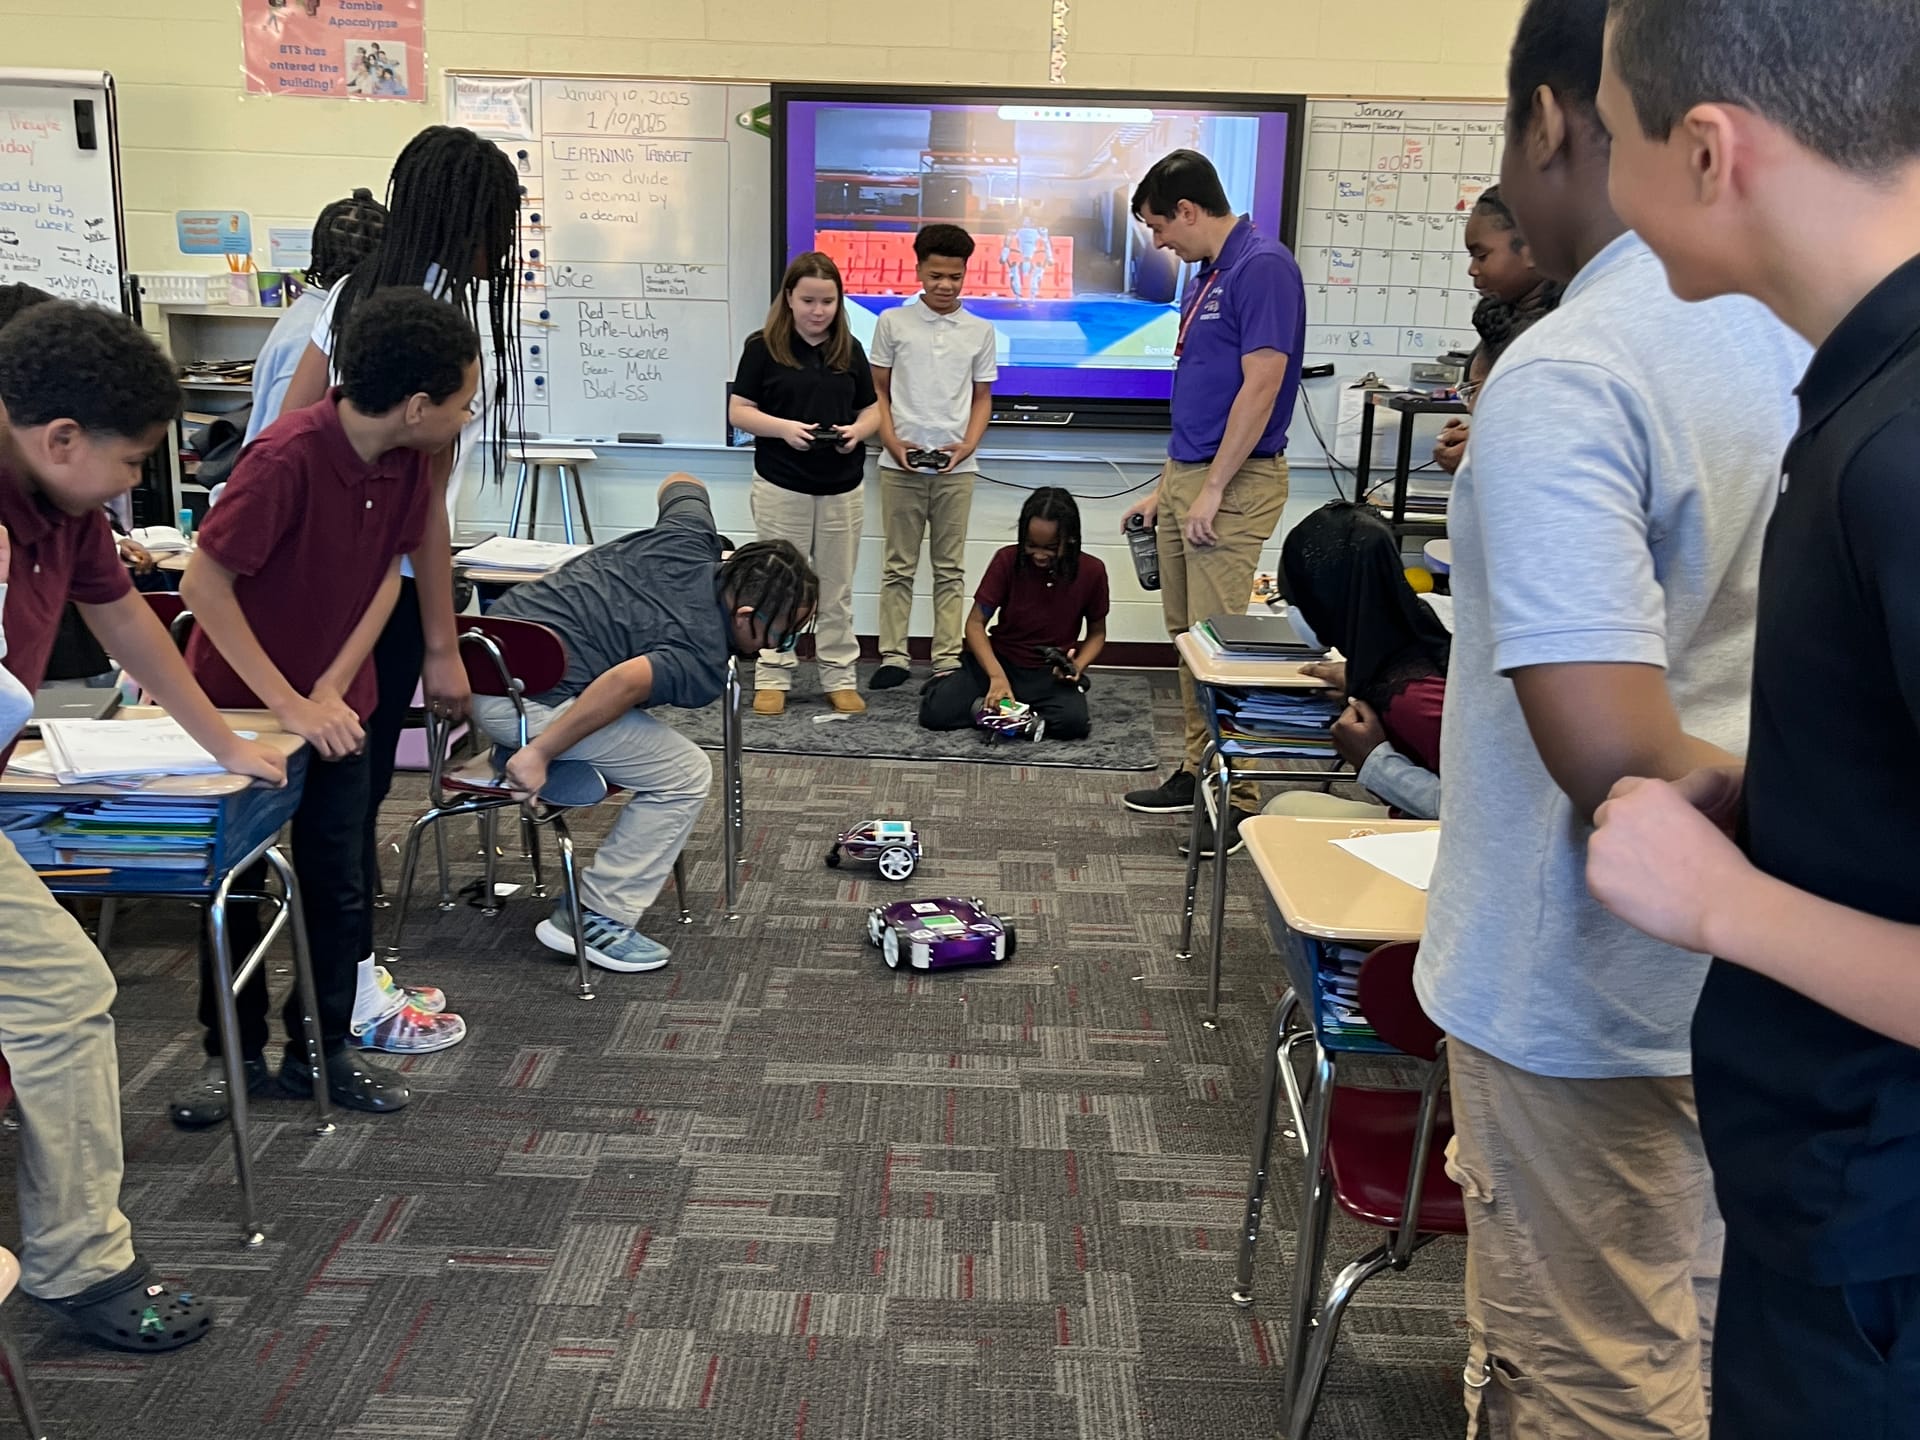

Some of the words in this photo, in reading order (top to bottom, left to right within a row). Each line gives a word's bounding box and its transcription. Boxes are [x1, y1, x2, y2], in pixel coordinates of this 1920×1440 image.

[339, 0, 383, 11] Zombie
[329, 16, 398, 30] Apocalypse
[280, 45, 302, 54] BTS
[305, 45, 327, 56] has
[269, 61, 316, 72] entered
[320, 63, 339, 73] the
[280, 77, 334, 91] building!
[557, 86, 619, 106] January
[623, 90, 644, 104] 10,
[648, 90, 690, 106] 2025
[1354, 102, 1404, 118] January
[551, 141, 634, 163] LEARNING
[638, 144, 693, 163] TARGET
[1377, 154, 1424, 171] 2025
[560, 168, 579, 181] I
[622, 167, 669, 186] divide
[549, 265, 595, 289] Voice
[626, 362, 662, 381] Math
